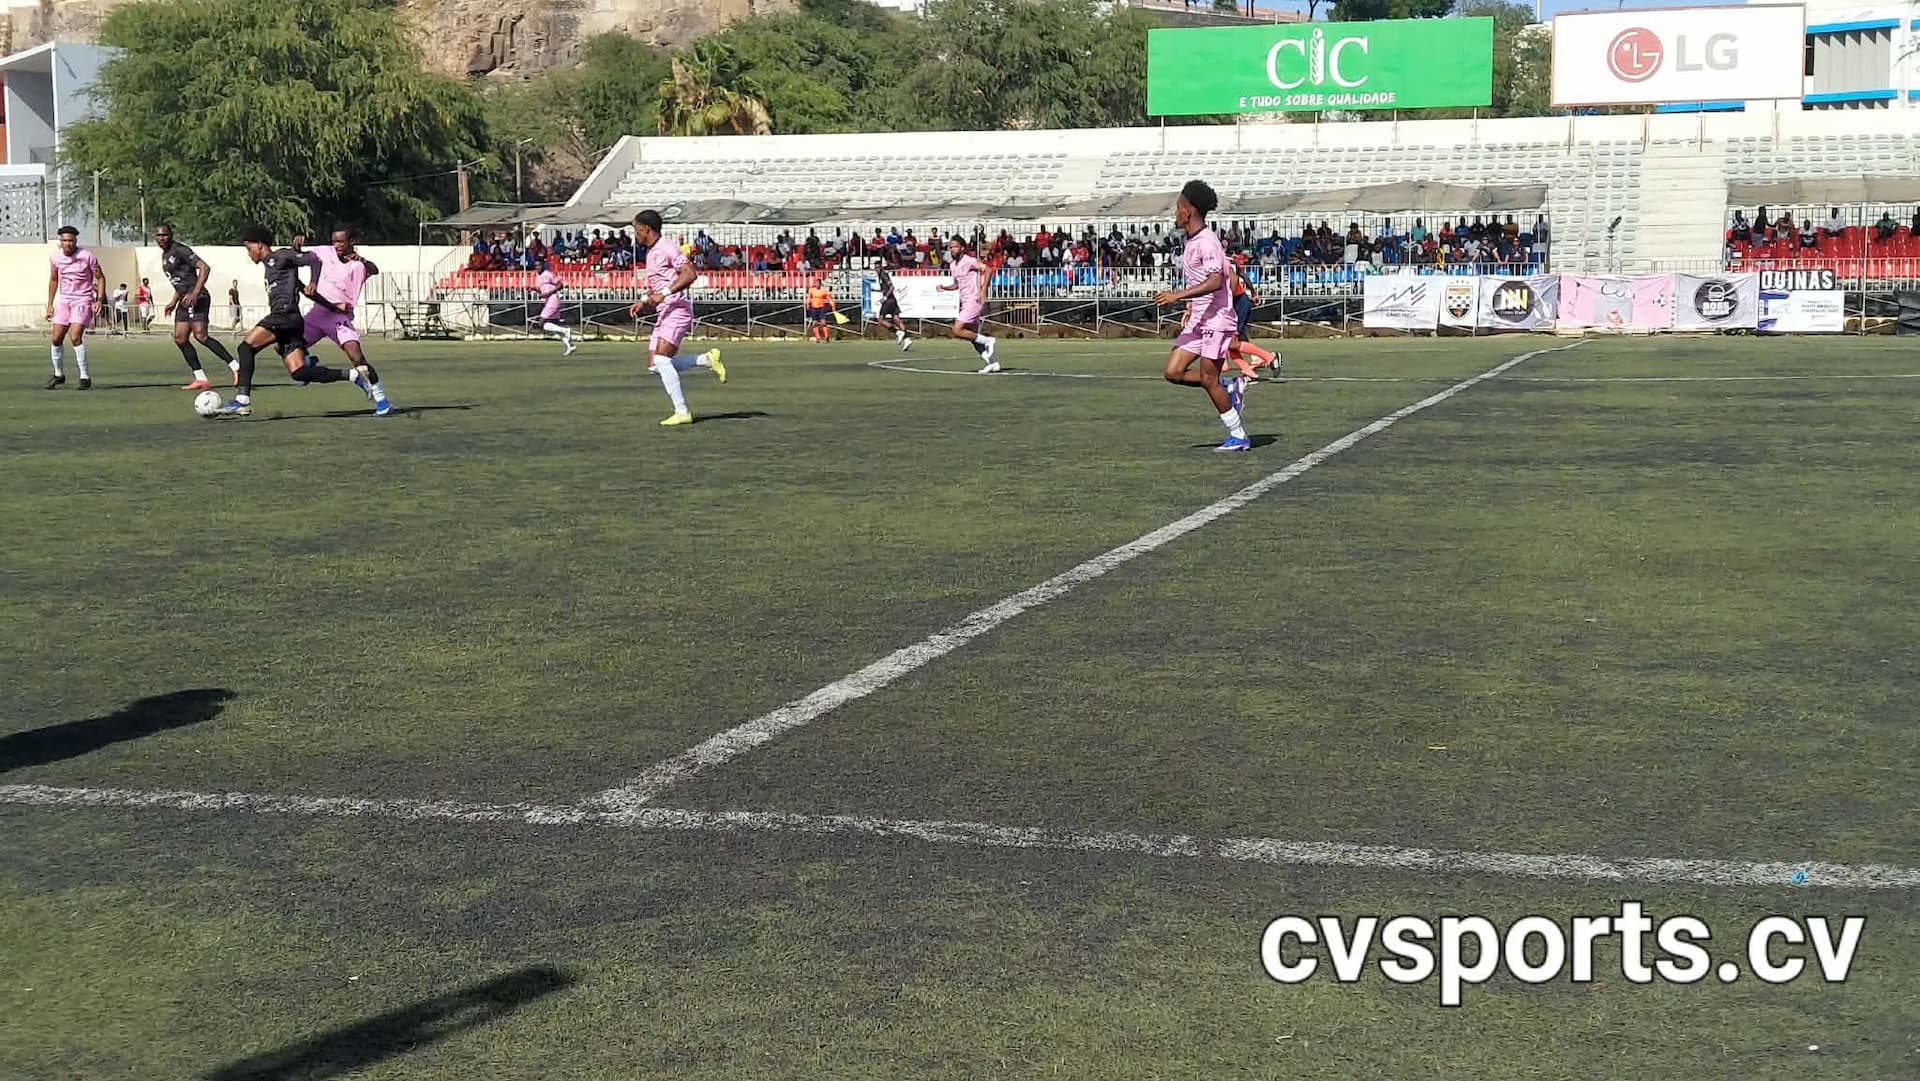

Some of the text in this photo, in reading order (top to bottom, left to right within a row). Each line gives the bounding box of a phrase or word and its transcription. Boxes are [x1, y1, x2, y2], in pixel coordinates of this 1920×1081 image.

[1676, 32, 1739, 71] LG
[1239, 91, 1396, 108] E TUDO SOBRE QUALIDADE
[1761, 270, 1833, 290] QUINAS
